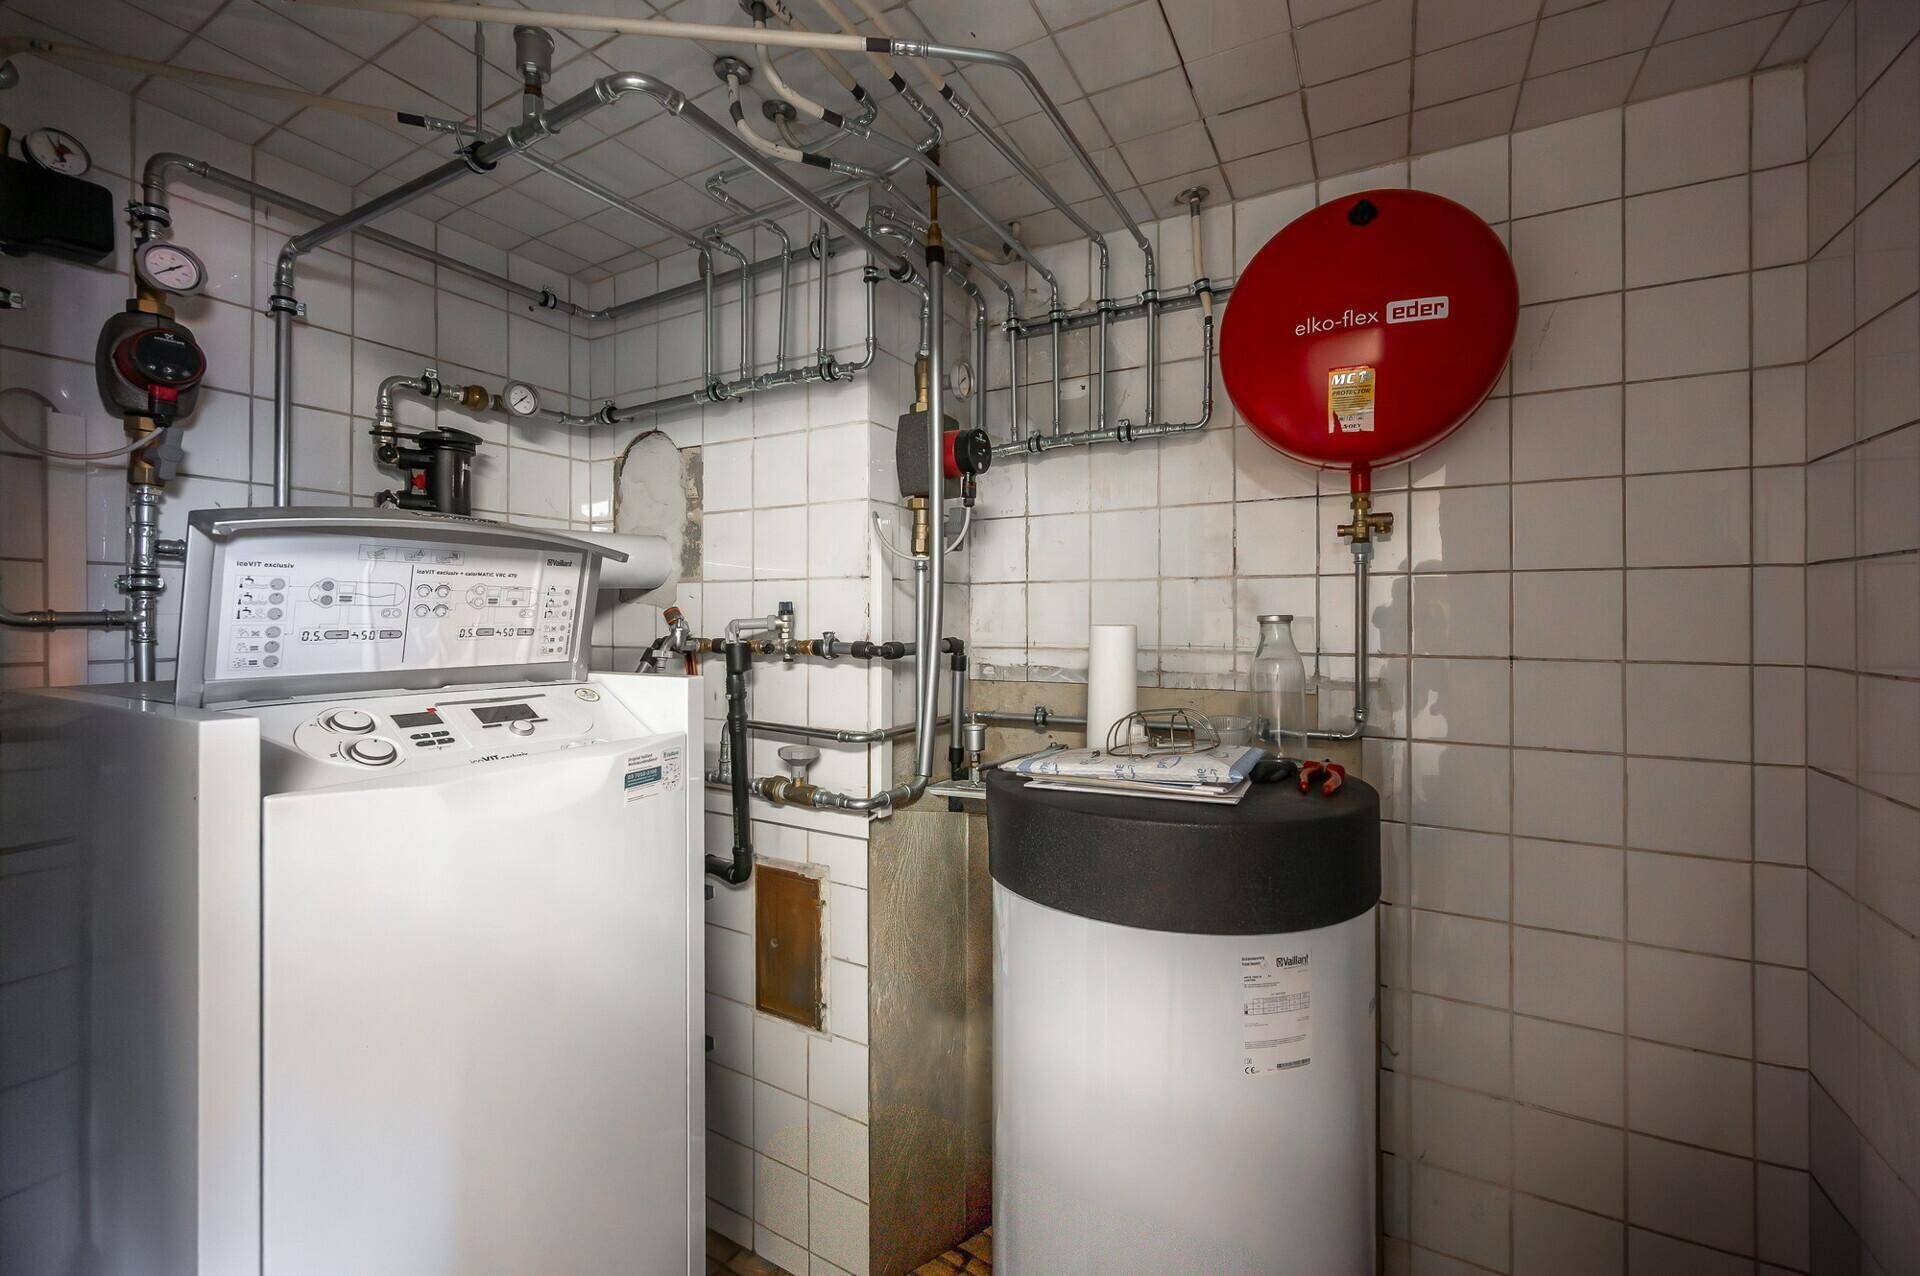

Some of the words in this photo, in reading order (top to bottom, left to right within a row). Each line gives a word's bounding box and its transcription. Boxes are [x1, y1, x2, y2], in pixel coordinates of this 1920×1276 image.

[1392, 301, 1445, 320] eder
[1295, 310, 1379, 336] elko-flex
[1283, 954, 1309, 967] Vaillant
